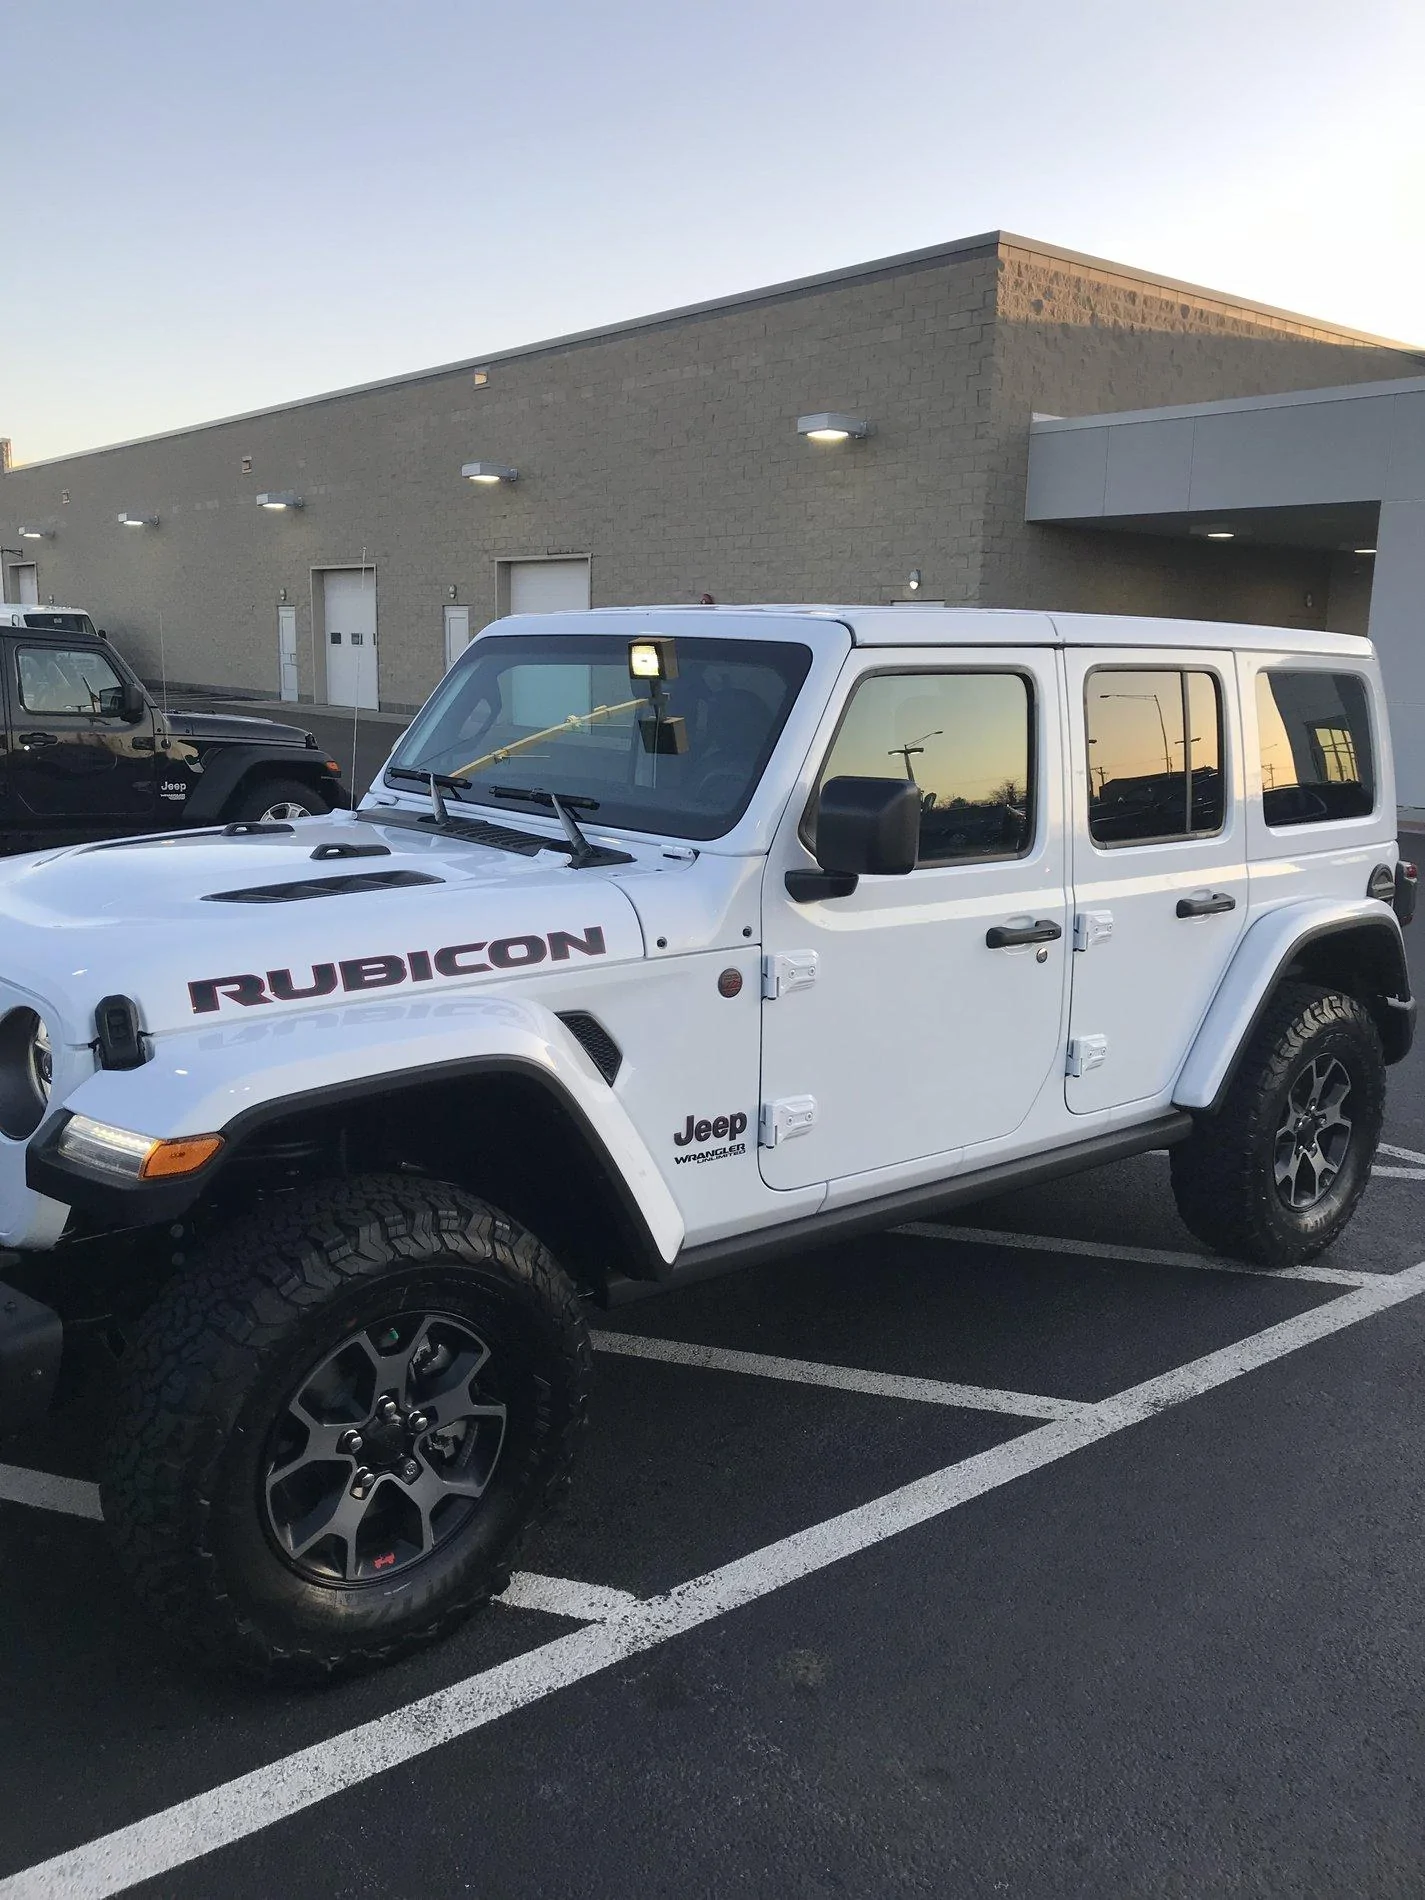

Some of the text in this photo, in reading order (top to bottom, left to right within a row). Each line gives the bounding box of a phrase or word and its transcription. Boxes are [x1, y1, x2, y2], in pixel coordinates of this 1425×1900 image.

[161, 781, 187, 792] Jeep
[187, 926, 607, 1014] RUBICON
[674, 1112, 747, 1146] Jeep
[674, 1143, 746, 1164] WRANGLER
